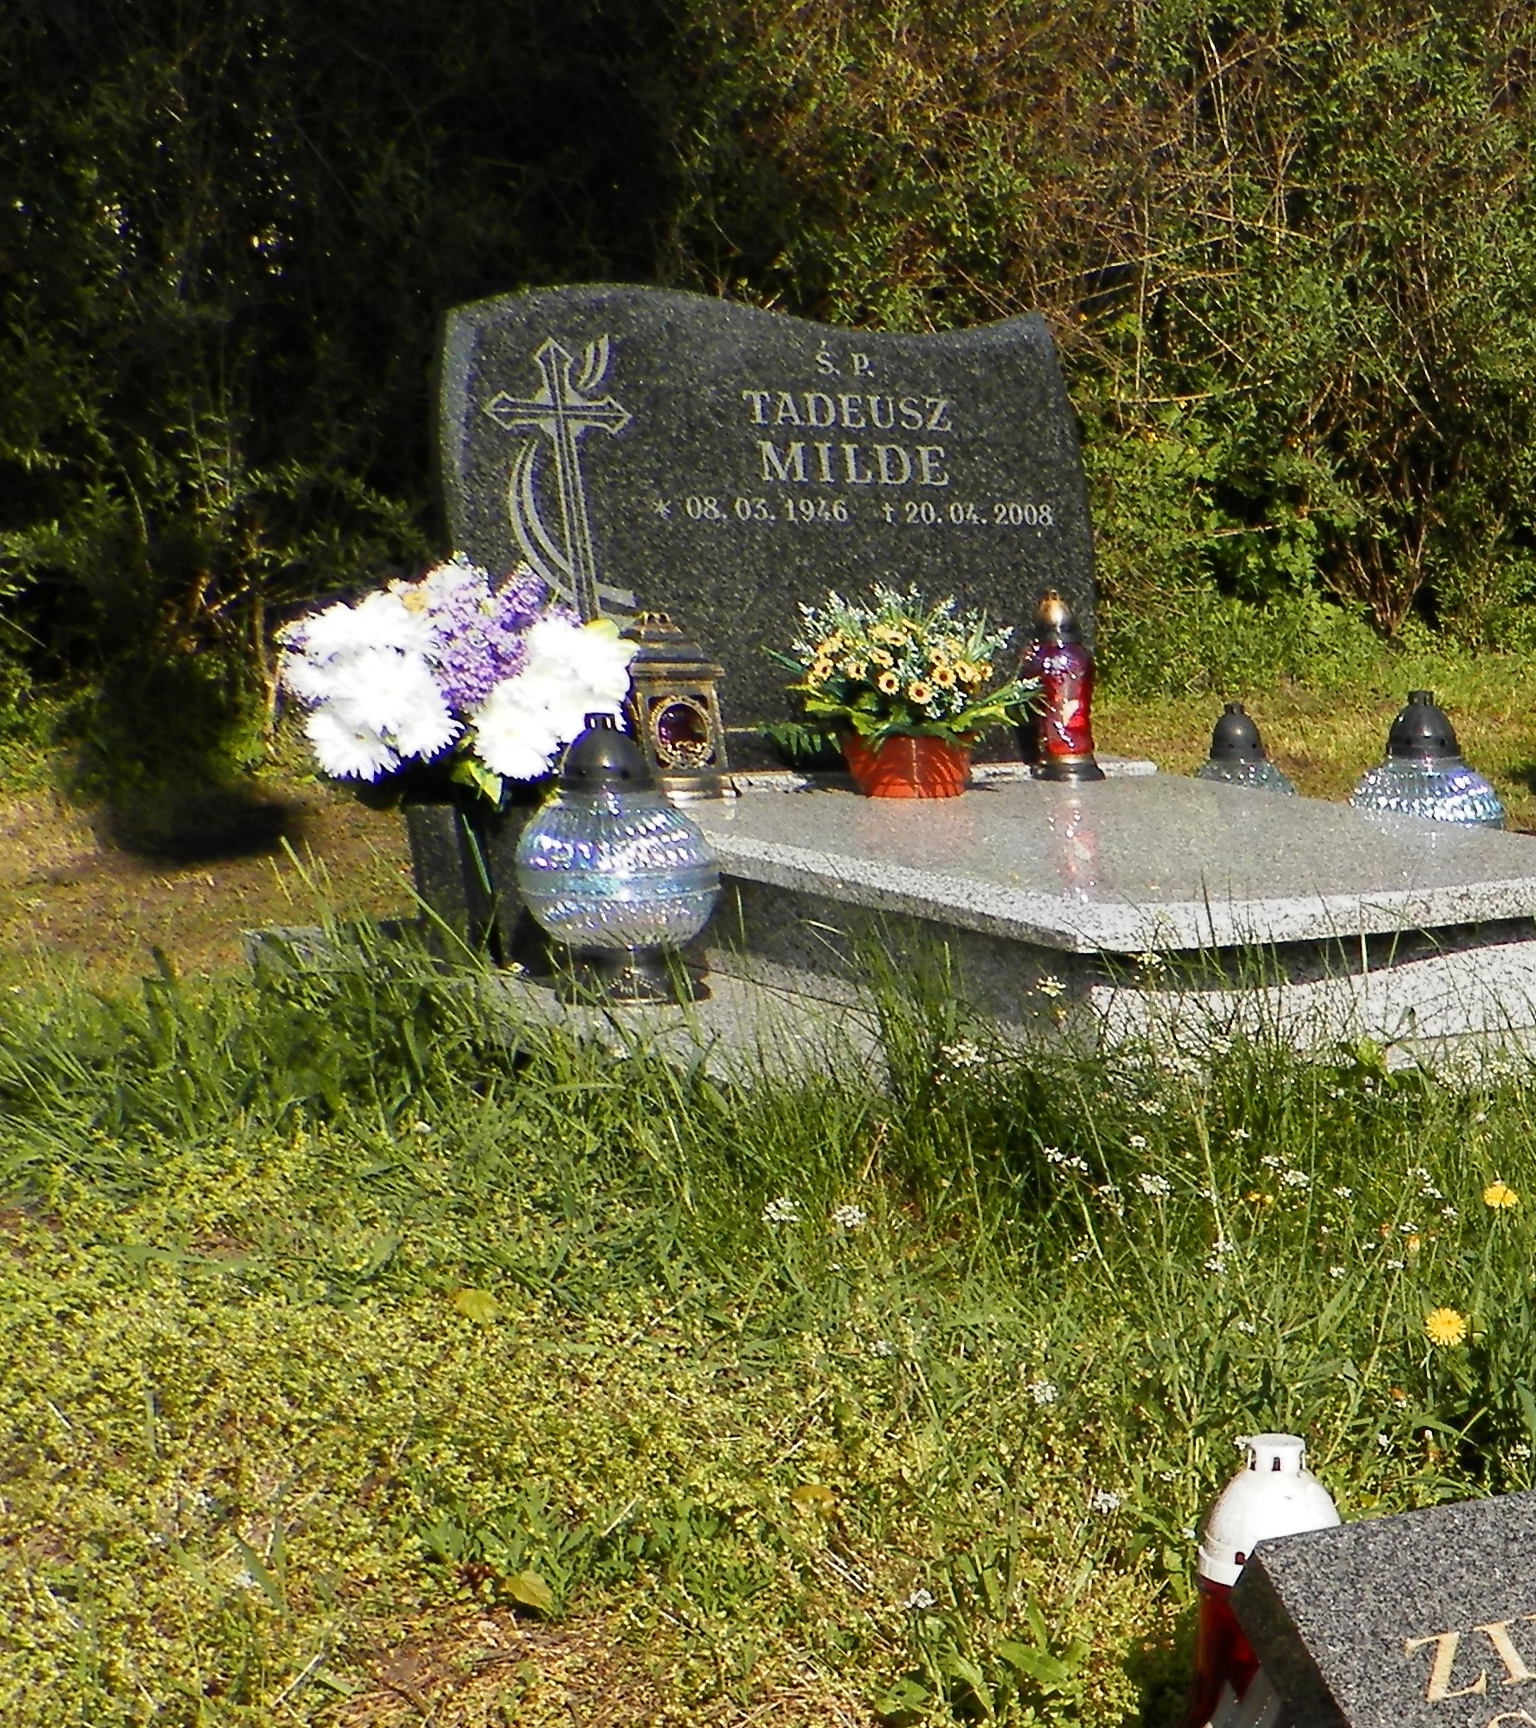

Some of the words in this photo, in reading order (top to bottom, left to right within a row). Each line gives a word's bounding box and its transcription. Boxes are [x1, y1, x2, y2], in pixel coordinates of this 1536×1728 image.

[741, 389, 953, 433] TADEUSZ
[756, 439, 952, 487] MILDE
[784, 497, 849, 523] 1946
[994, 502, 1054, 527] 2008
